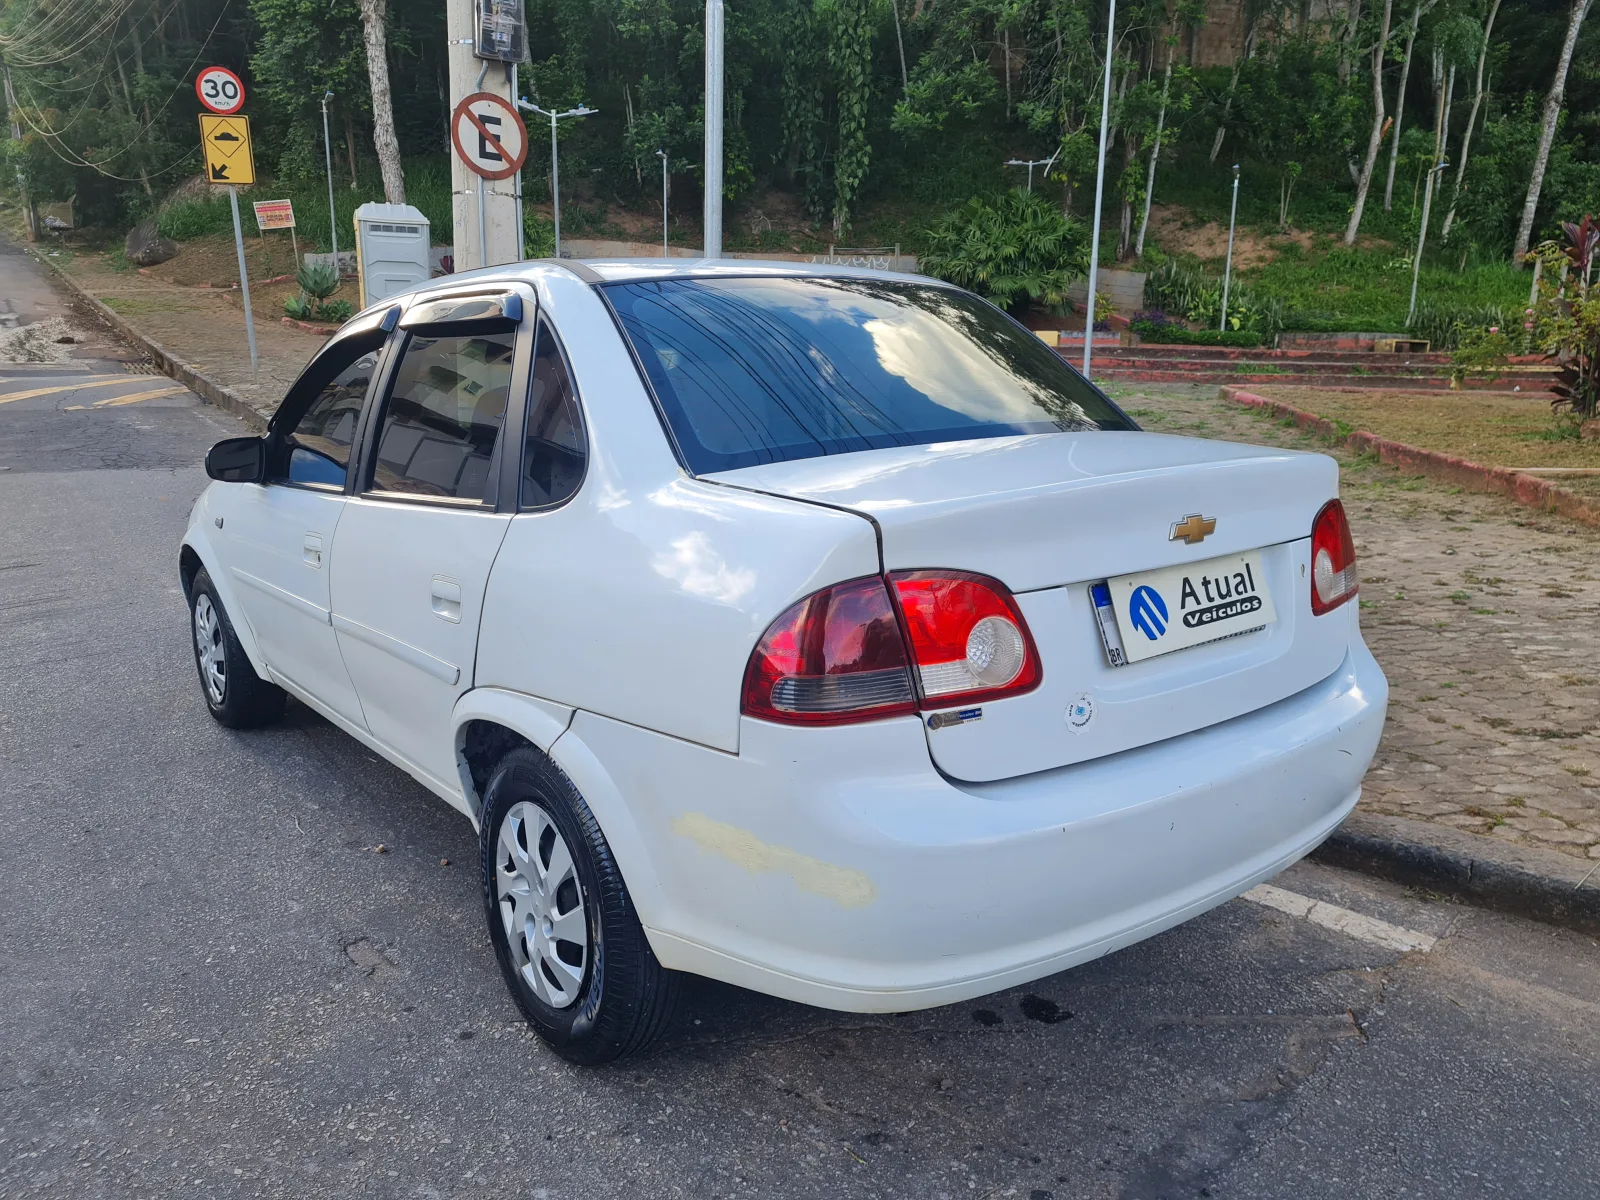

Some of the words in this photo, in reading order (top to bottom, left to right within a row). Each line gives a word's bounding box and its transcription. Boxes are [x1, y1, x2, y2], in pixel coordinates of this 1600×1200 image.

[203, 78, 239, 100] 30
[478, 113, 503, 162] E
[1180, 562, 1256, 610] Atual
[1110, 647, 1123, 664] BR
